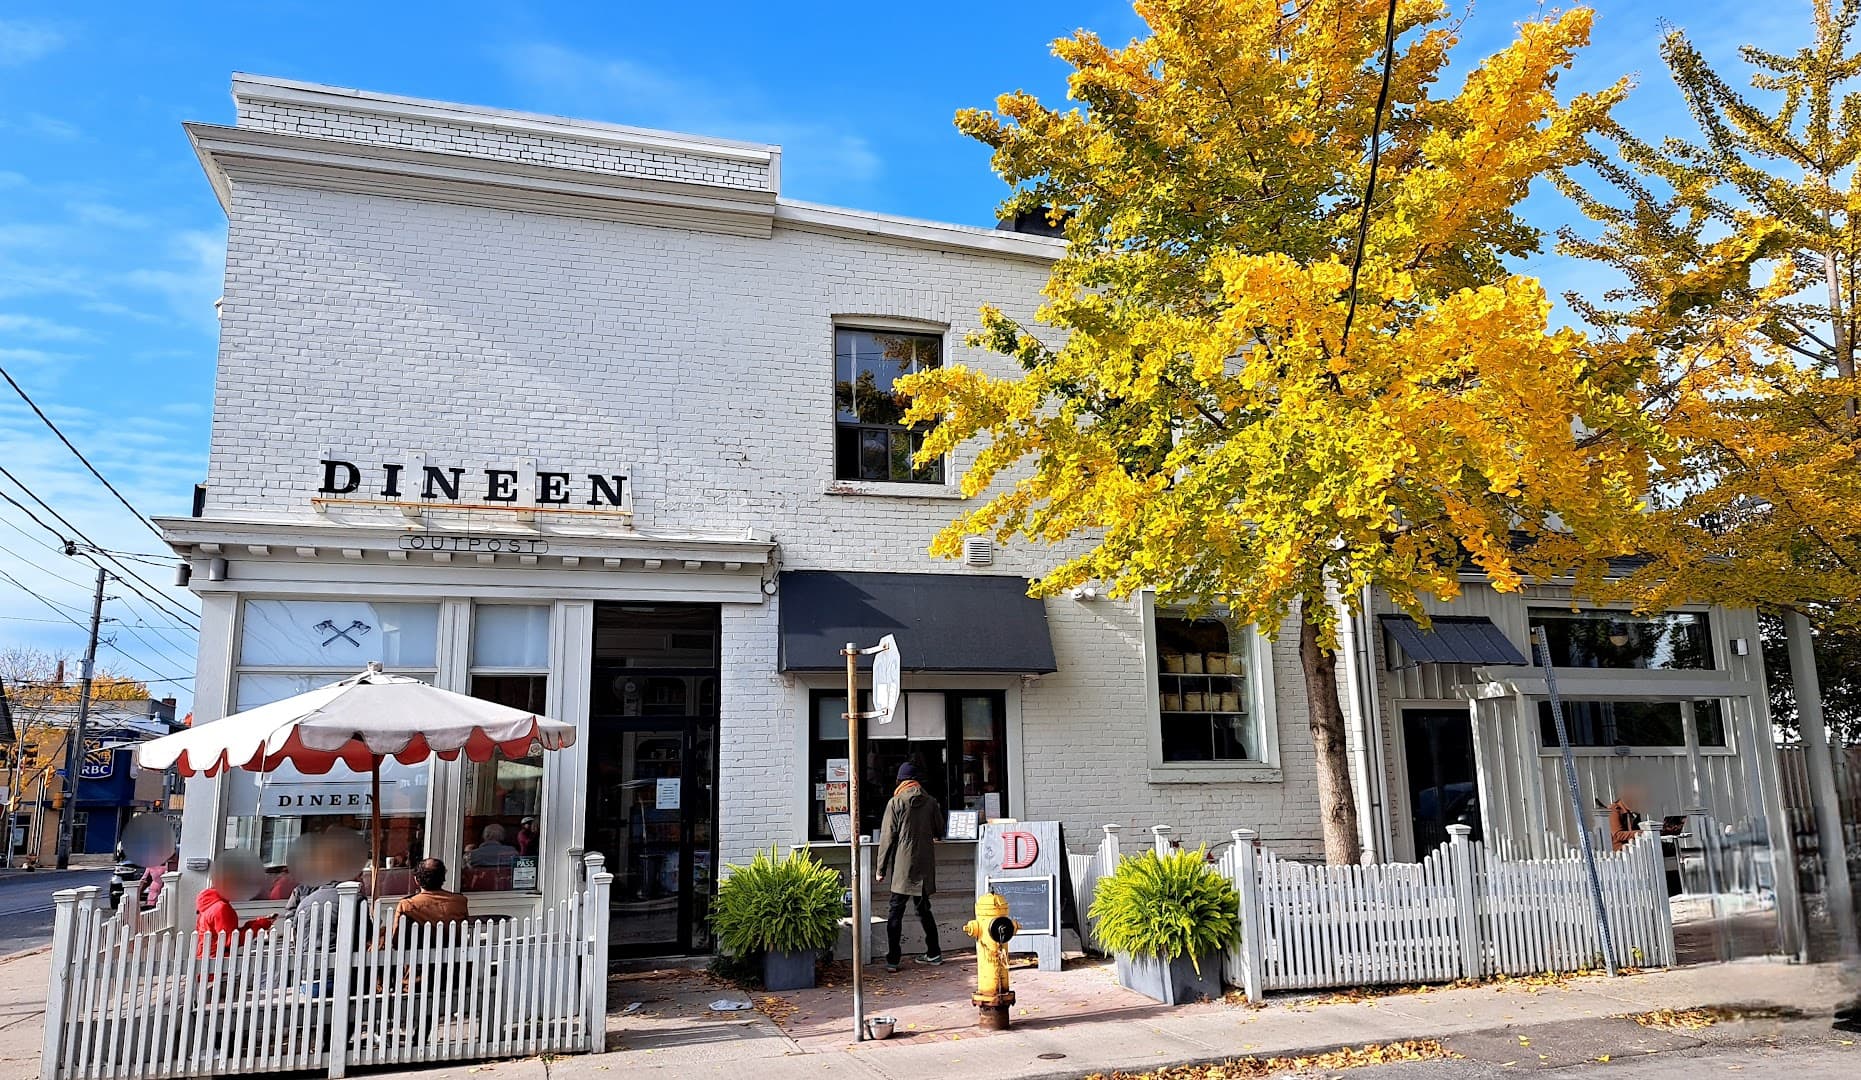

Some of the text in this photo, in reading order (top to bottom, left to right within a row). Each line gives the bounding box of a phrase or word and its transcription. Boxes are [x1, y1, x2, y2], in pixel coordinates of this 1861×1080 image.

[318, 460, 628, 507] DINEEN
[411, 536, 538, 553] OUTPOST
[81, 765, 108, 774] RBC
[1001, 832, 1039, 870] D
[516, 860, 535, 868] PASS
